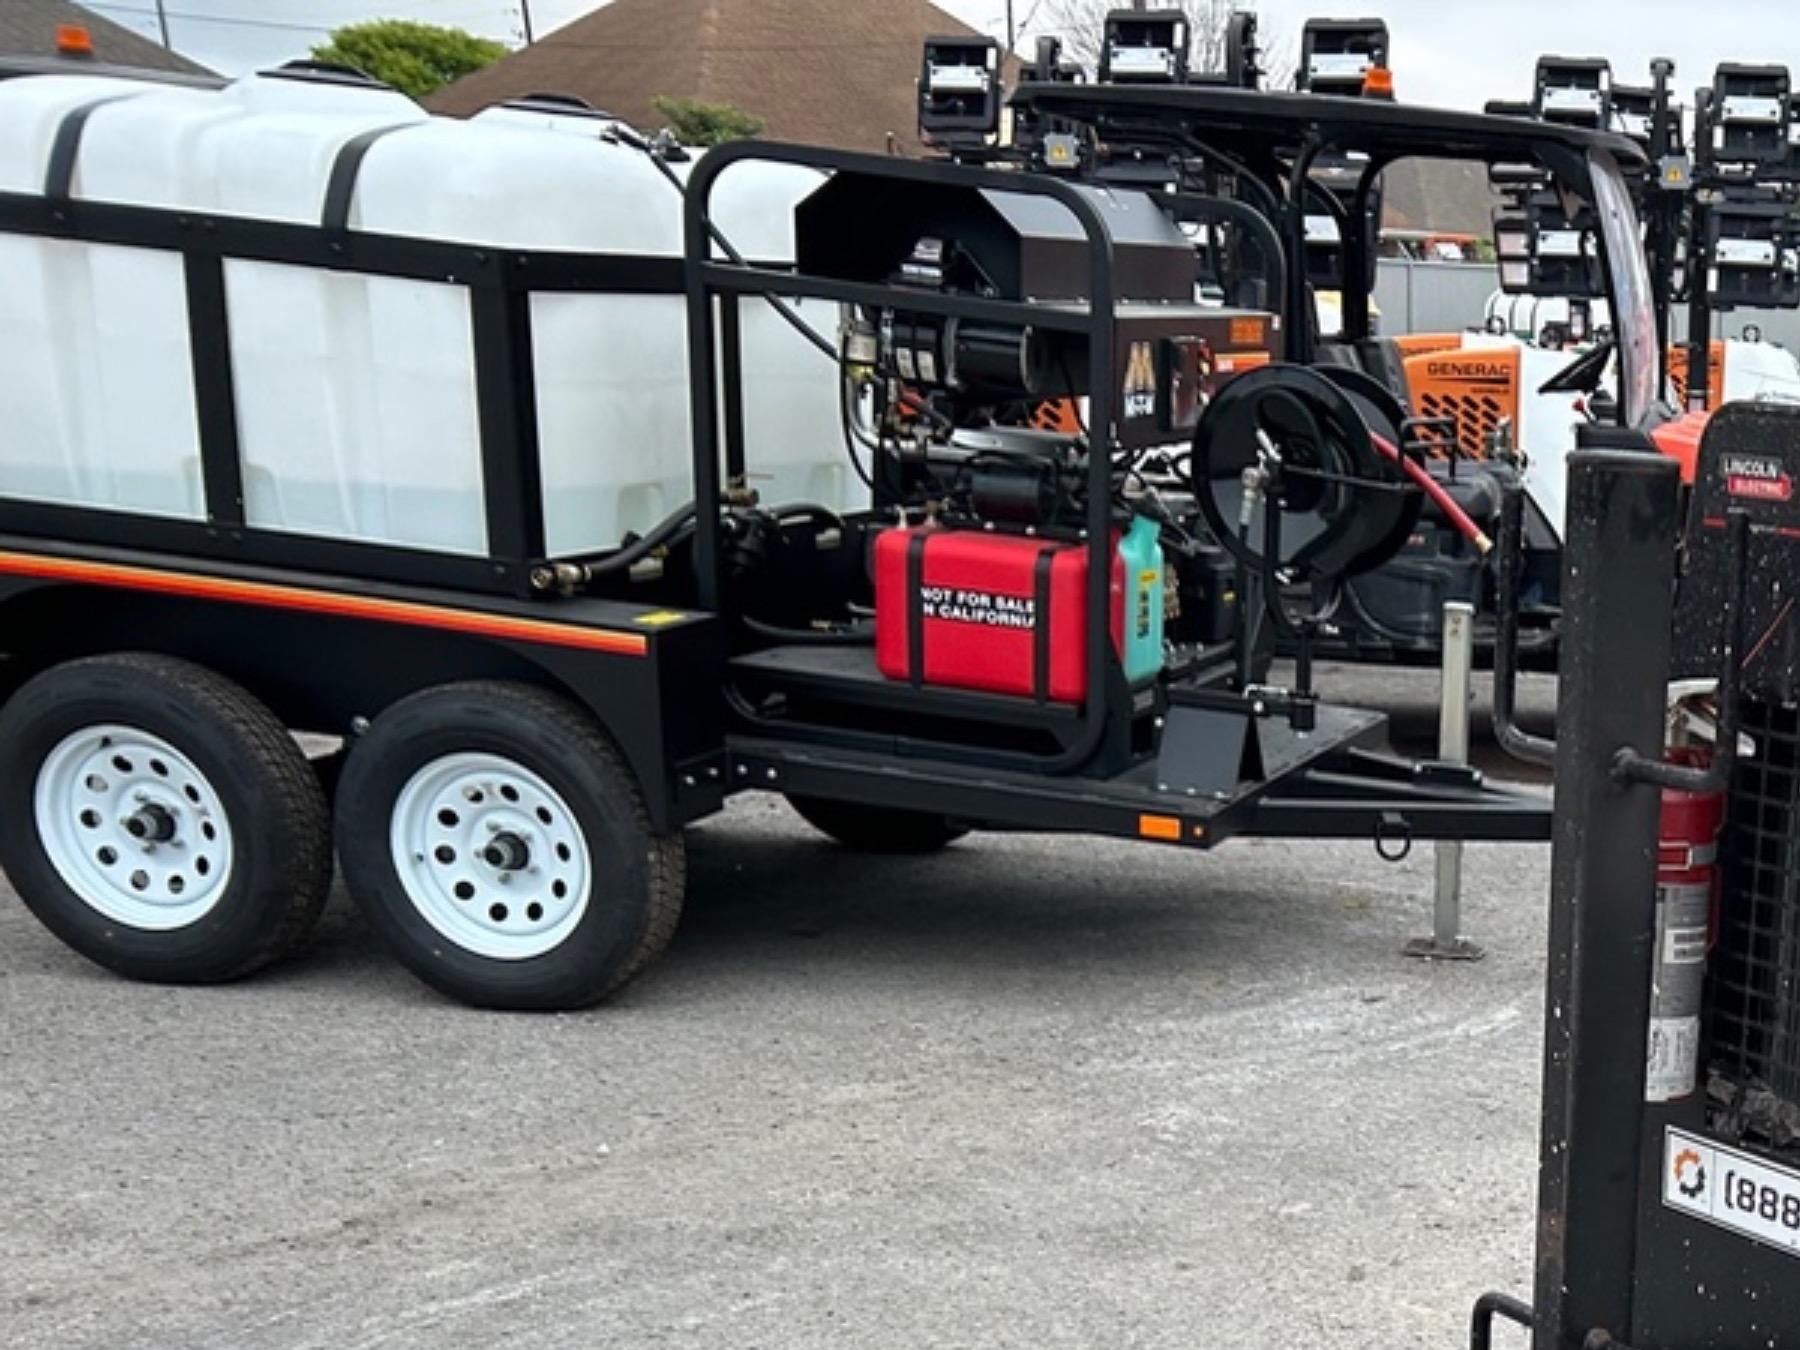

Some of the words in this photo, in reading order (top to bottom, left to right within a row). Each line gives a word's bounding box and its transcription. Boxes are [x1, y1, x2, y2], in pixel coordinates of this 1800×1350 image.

[1427, 362, 1511, 377] GENERAC
[1723, 457, 1778, 479] LINCOLN
[956, 591, 991, 608] FOR
[996, 595, 1035, 614] SALE
